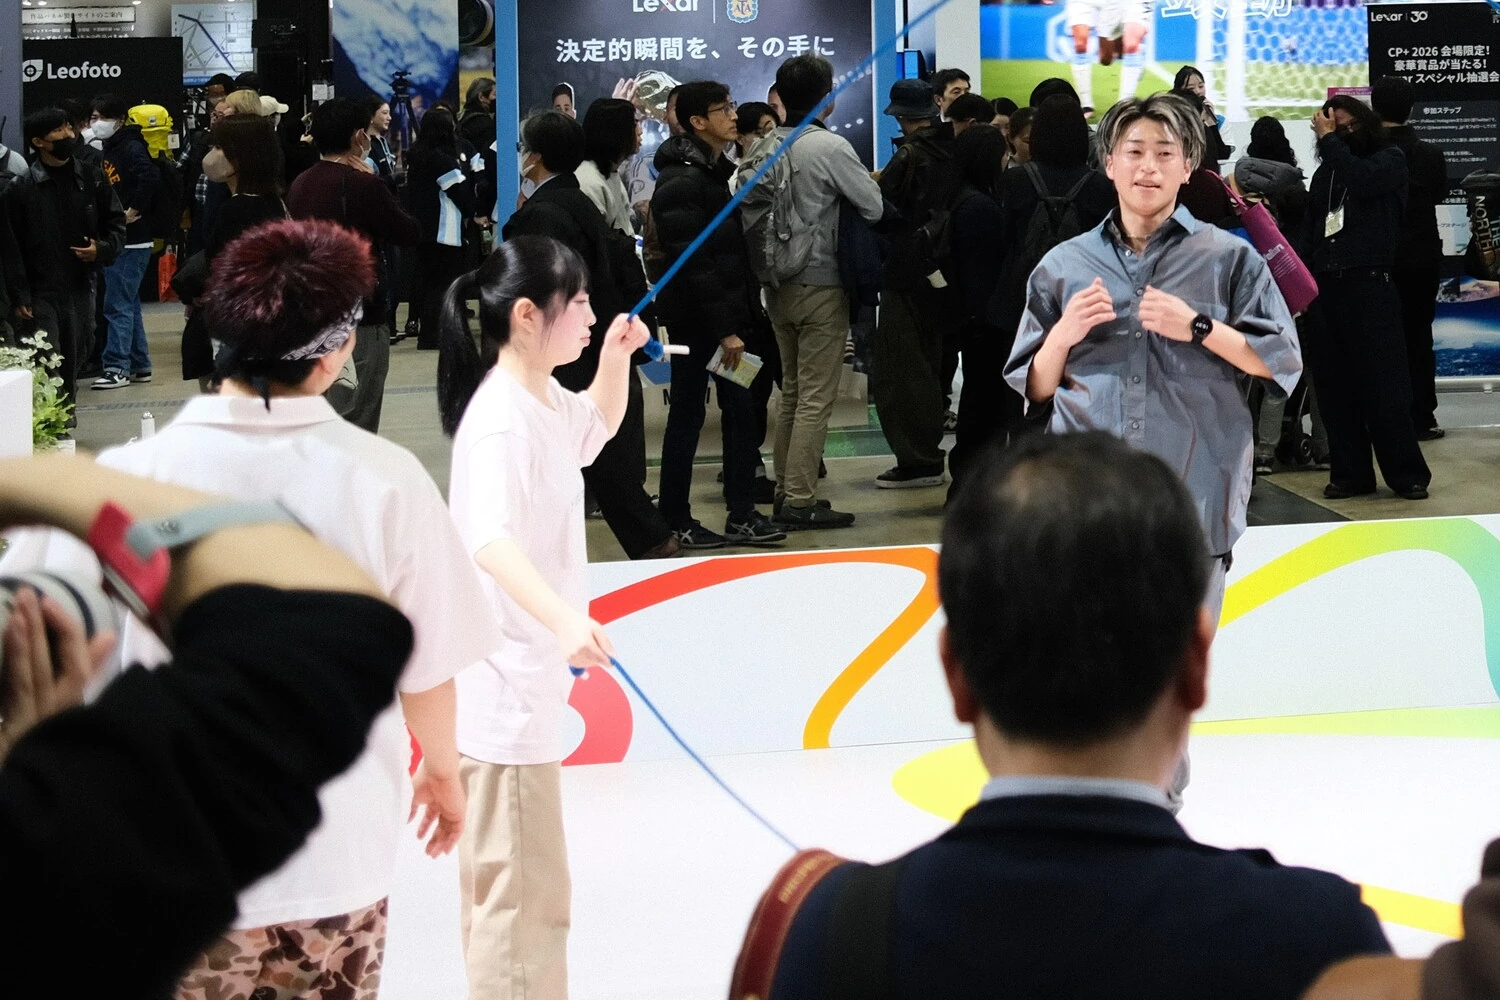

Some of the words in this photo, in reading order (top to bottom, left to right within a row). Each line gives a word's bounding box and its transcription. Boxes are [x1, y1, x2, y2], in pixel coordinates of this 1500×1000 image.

[1371, 11, 1403, 22] Lexar
[556, 34, 835, 63] 決定的瞬間を、その手に
[1387, 47, 1409, 57] CP+
[1411, 46, 1439, 57] 2026
[47, 61, 122, 79] Leofoto
[1415, 71, 1500, 83] スペシャル抽選会
[1475, 195, 1493, 254] NORTH
